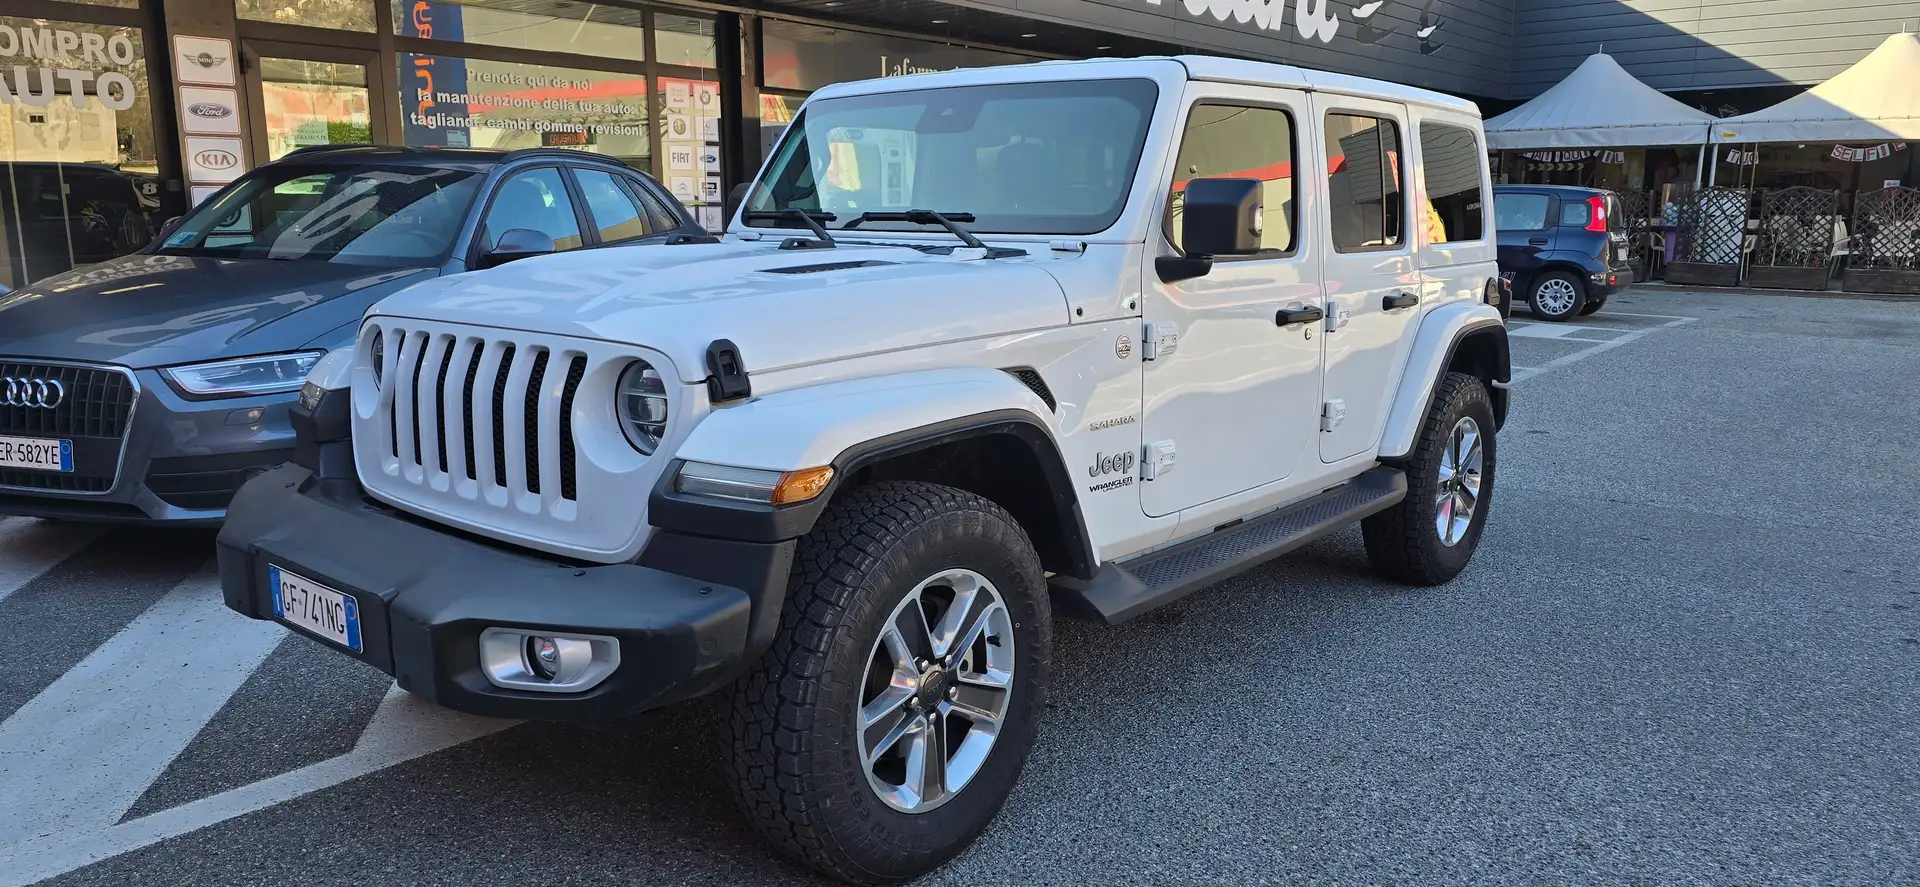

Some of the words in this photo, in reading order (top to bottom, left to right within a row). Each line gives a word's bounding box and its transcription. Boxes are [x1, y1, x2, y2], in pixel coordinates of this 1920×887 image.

[466, 68, 523, 85] Prenota
[527, 75, 548, 88] qui
[552, 77, 569, 88] da
[573, 79, 592, 90] noi
[417, 87, 432, 102] la
[437, 92, 539, 108] manutenzione
[543, 98, 575, 111] della
[580, 100, 600, 112] tua
[197, 104, 224, 116] Ford
[486, 117, 530, 131] cambi
[591, 122, 642, 137] revisioni
[202, 153, 231, 165] KIA
[672, 152, 690, 164] FIAT
[1089, 415, 1136, 432] SAHARA
[17, 443, 60, 465] 582YE
[1088, 451, 1135, 478] Jeep
[1089, 476, 1133, 492] WRANGLER
[282, 581, 297, 614] GF
[301, 588, 345, 634] 741NG
